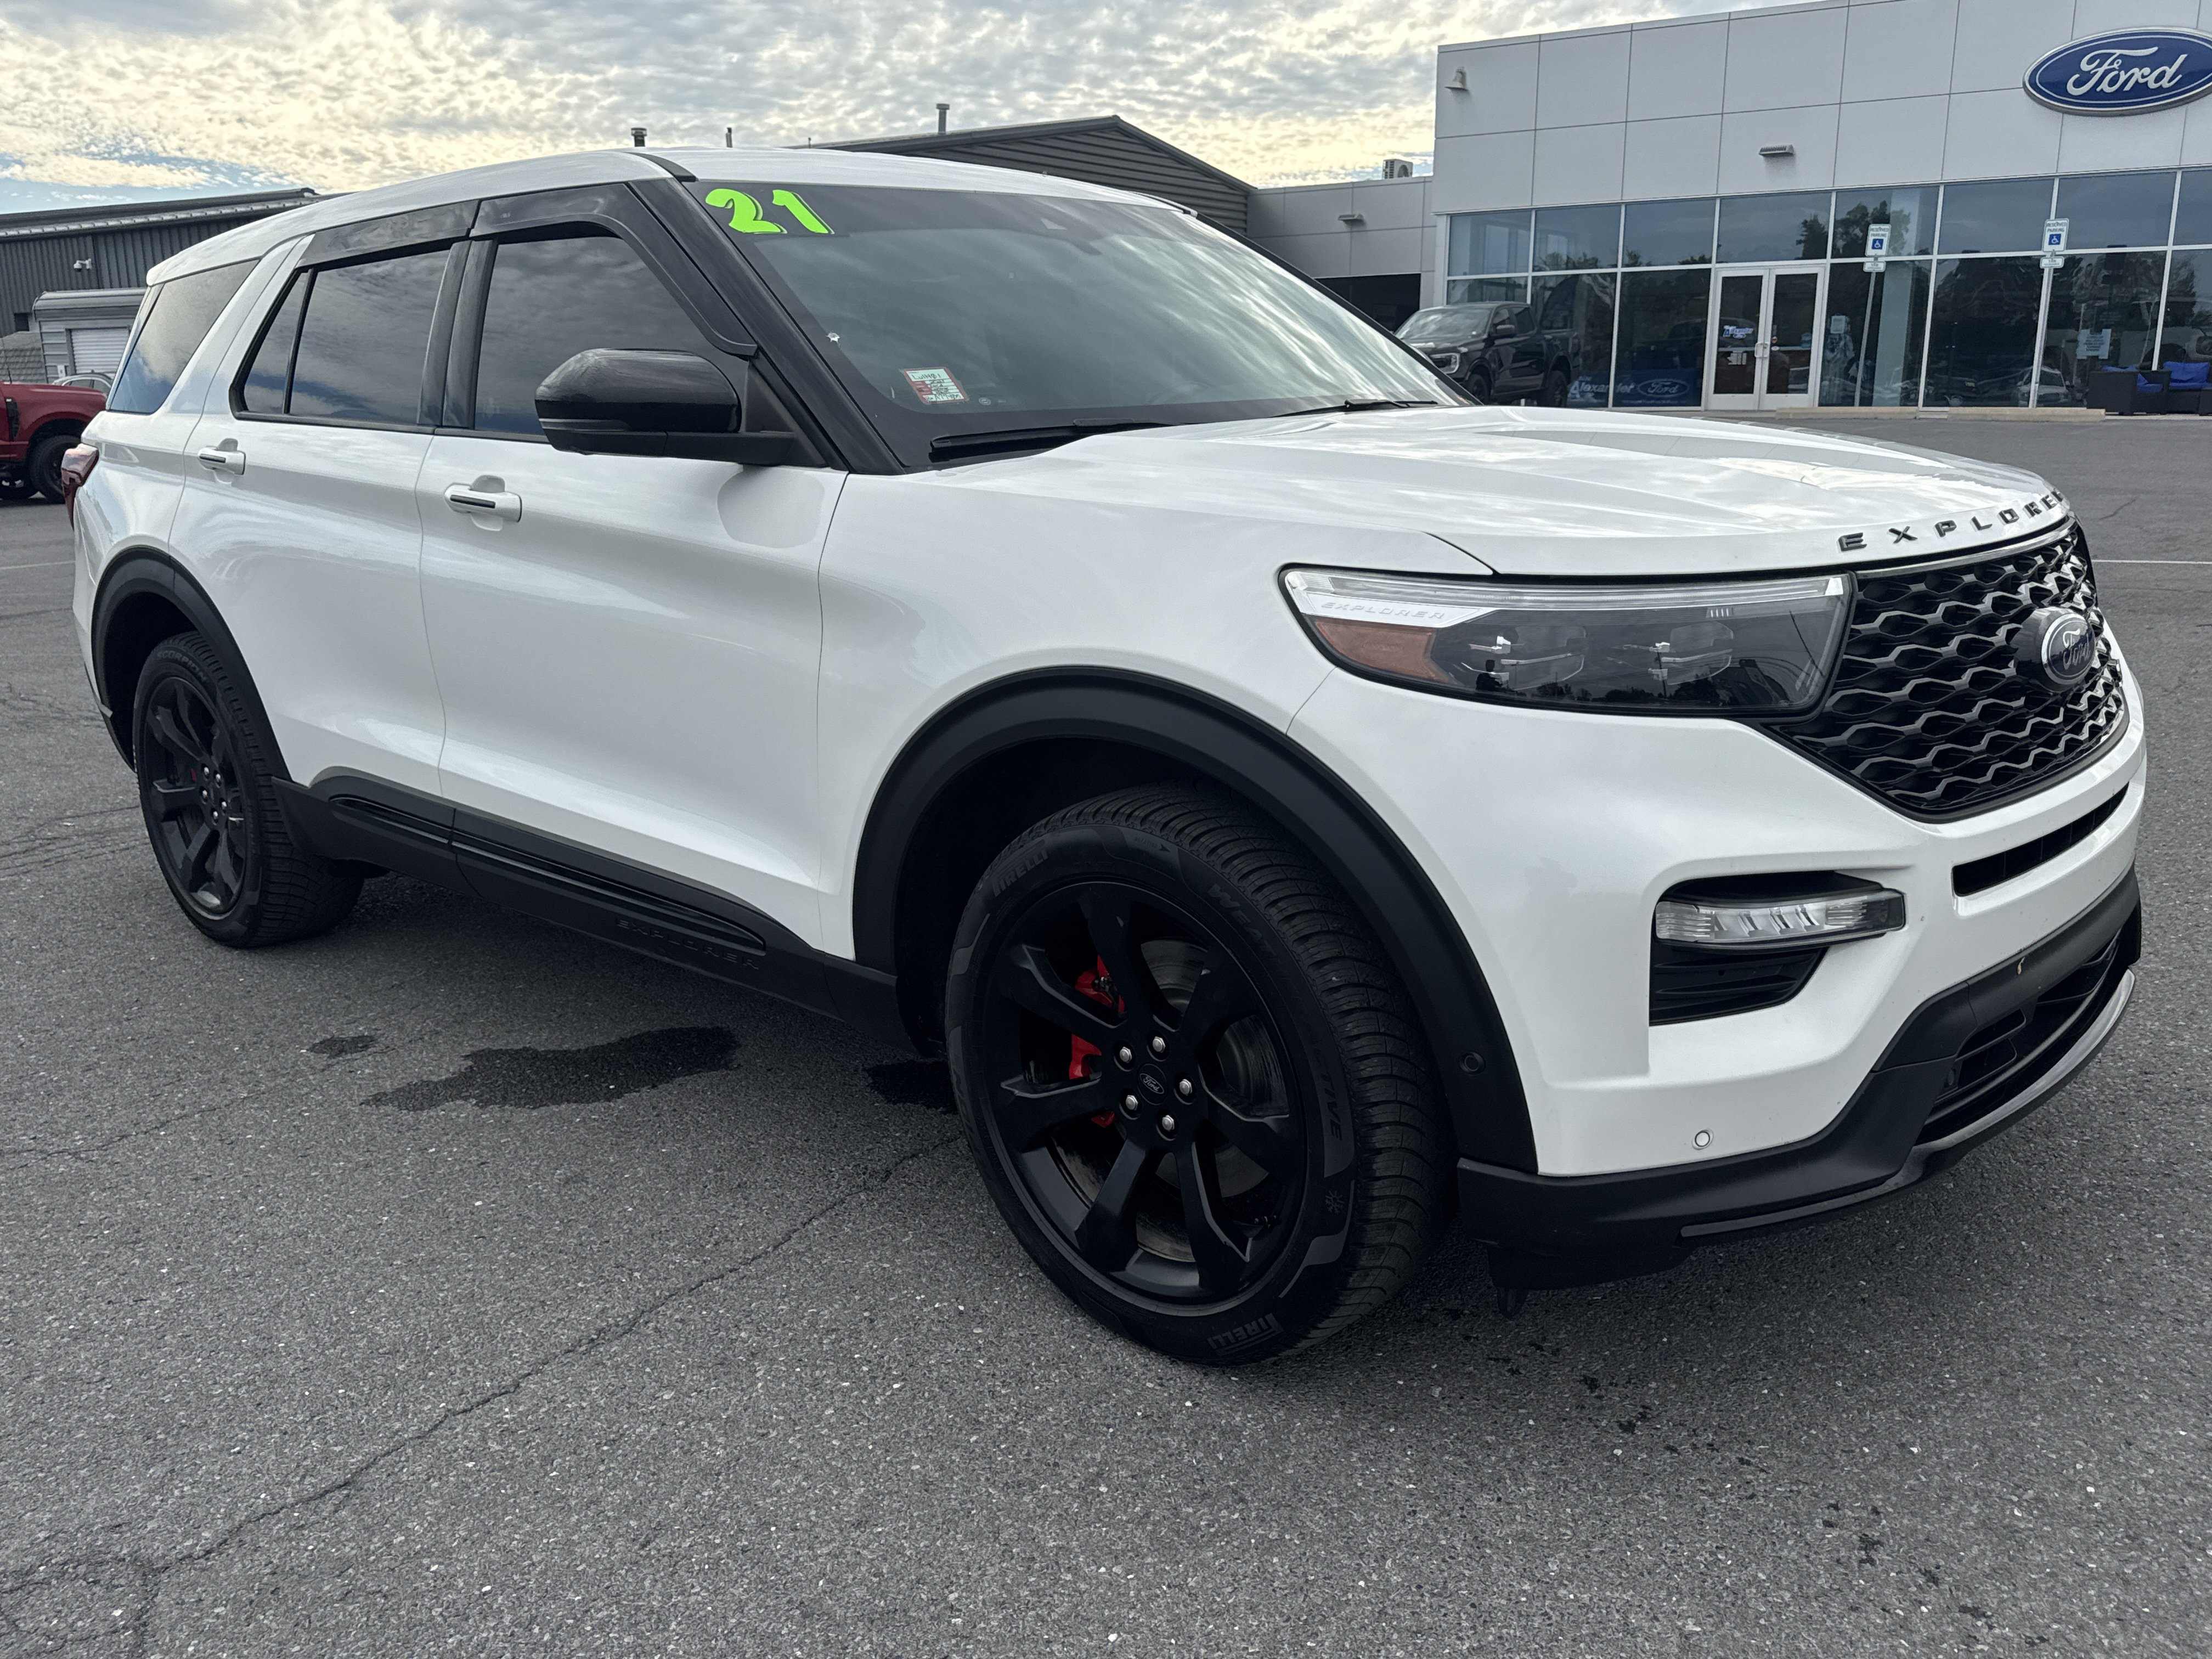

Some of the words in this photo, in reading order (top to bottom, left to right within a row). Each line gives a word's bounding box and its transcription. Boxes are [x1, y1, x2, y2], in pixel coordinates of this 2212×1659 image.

[2066, 46, 2188, 97] Ford
[705, 188, 835, 235] 21
[1647, 382, 1680, 394] Ford
[1321, 602, 1445, 619] EXPLORER
[2063, 628, 2091, 670] Ford
[990, 839, 1049, 898] PIRELLI
[615, 917, 759, 970] EXPLORER
[1143, 1076, 1160, 1092] Ford
[1206, 1312, 1285, 1357] PIRELLI
